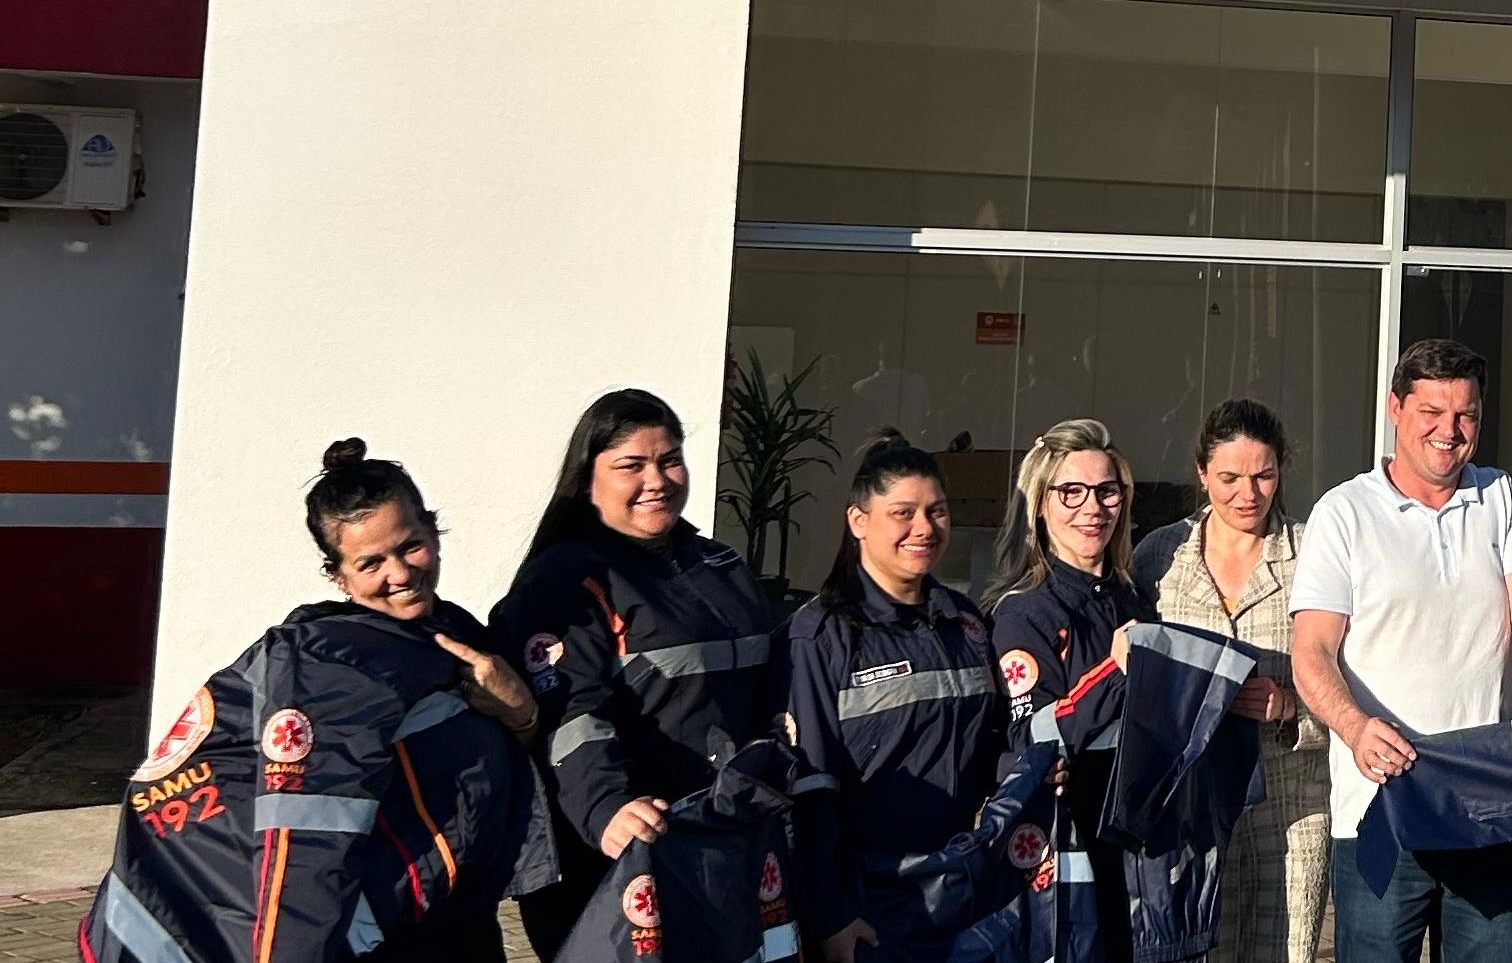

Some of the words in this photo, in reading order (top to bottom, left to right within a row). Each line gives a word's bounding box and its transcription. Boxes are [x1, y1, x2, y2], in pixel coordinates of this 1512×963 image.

[1011, 694, 1032, 708] AMU
[1011, 703, 1035, 722] 192
[264, 763, 306, 775] SAMU
[131, 761, 213, 813] SAMU
[264, 774, 305, 791] 192
[144, 785, 227, 838] 192
